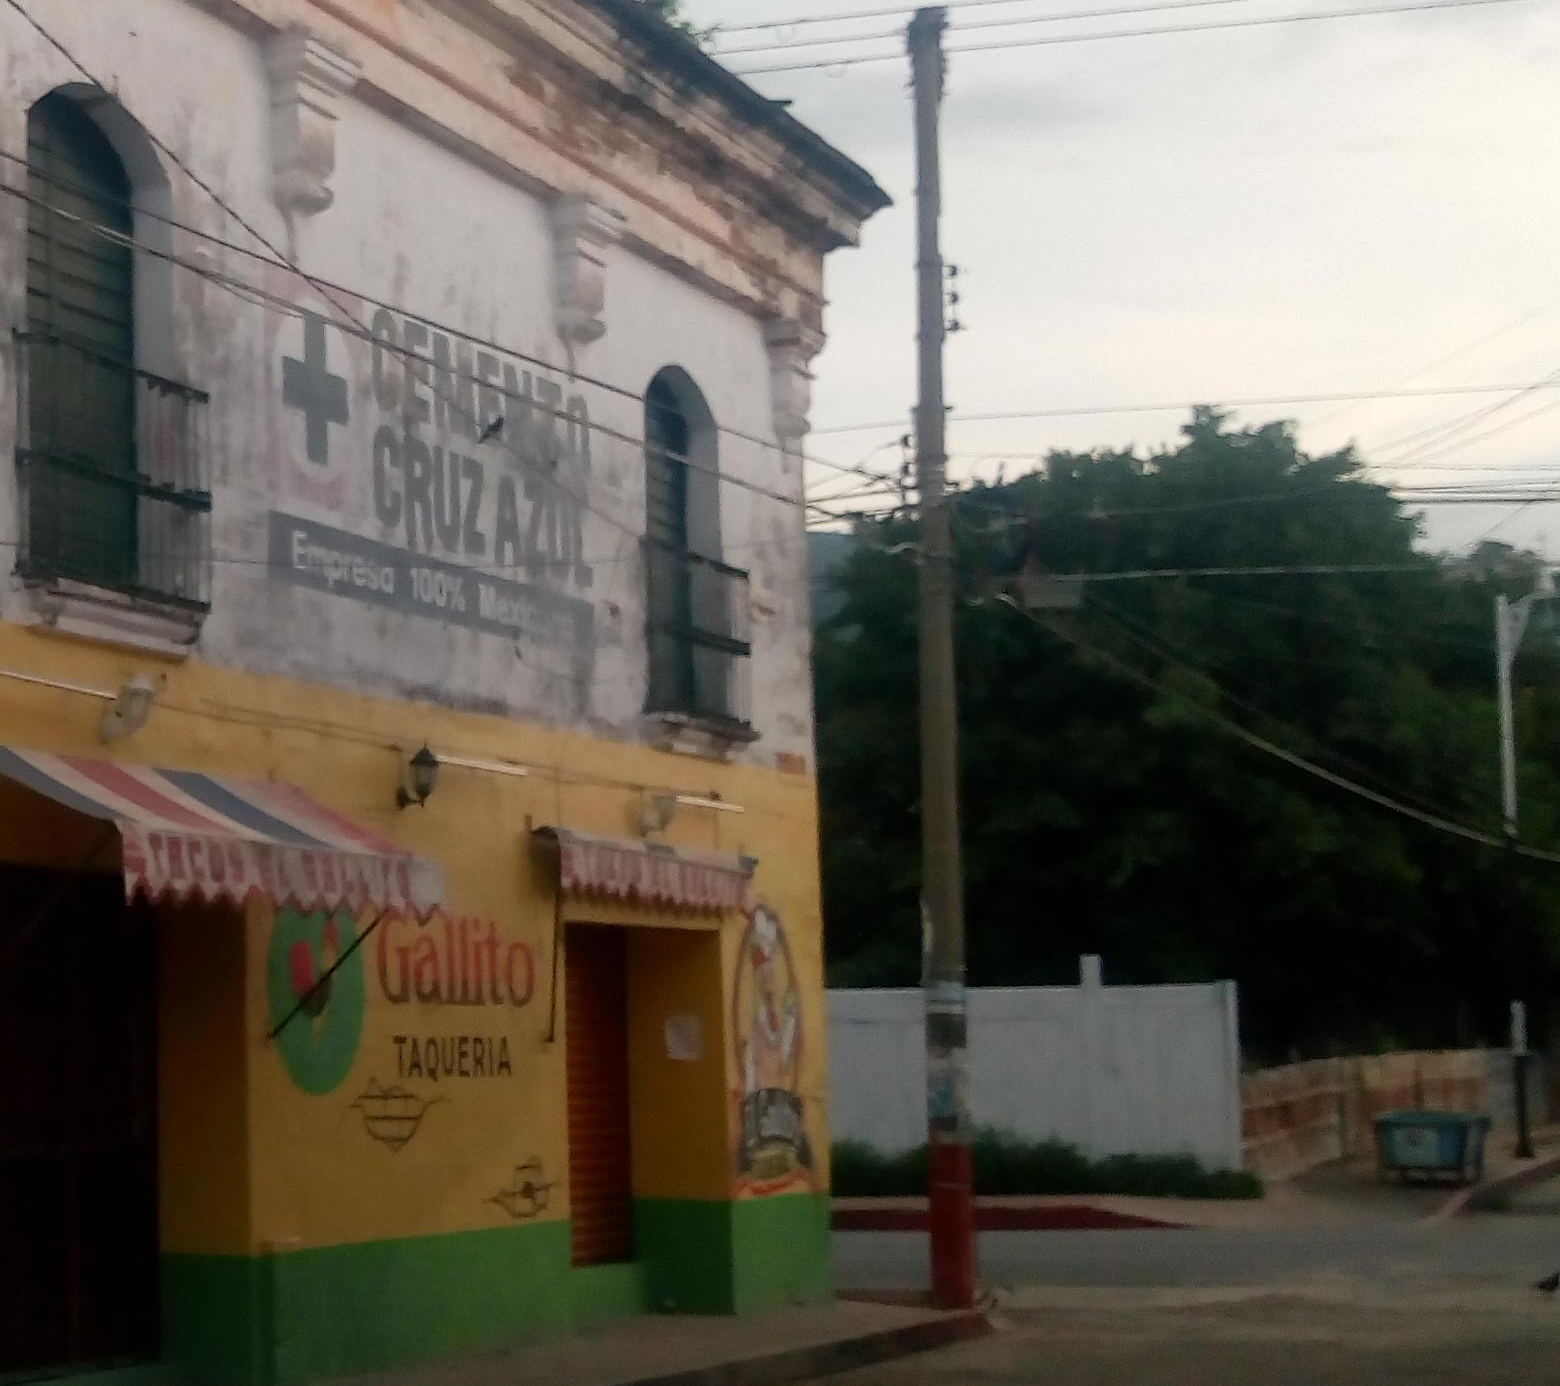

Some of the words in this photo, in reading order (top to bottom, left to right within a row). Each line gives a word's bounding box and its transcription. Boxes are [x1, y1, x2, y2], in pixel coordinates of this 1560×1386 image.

[373, 423, 485, 555] CRUZ
[377, 911, 536, 1008] Gallito
[393, 1034, 513, 1082] TAQUERIA
